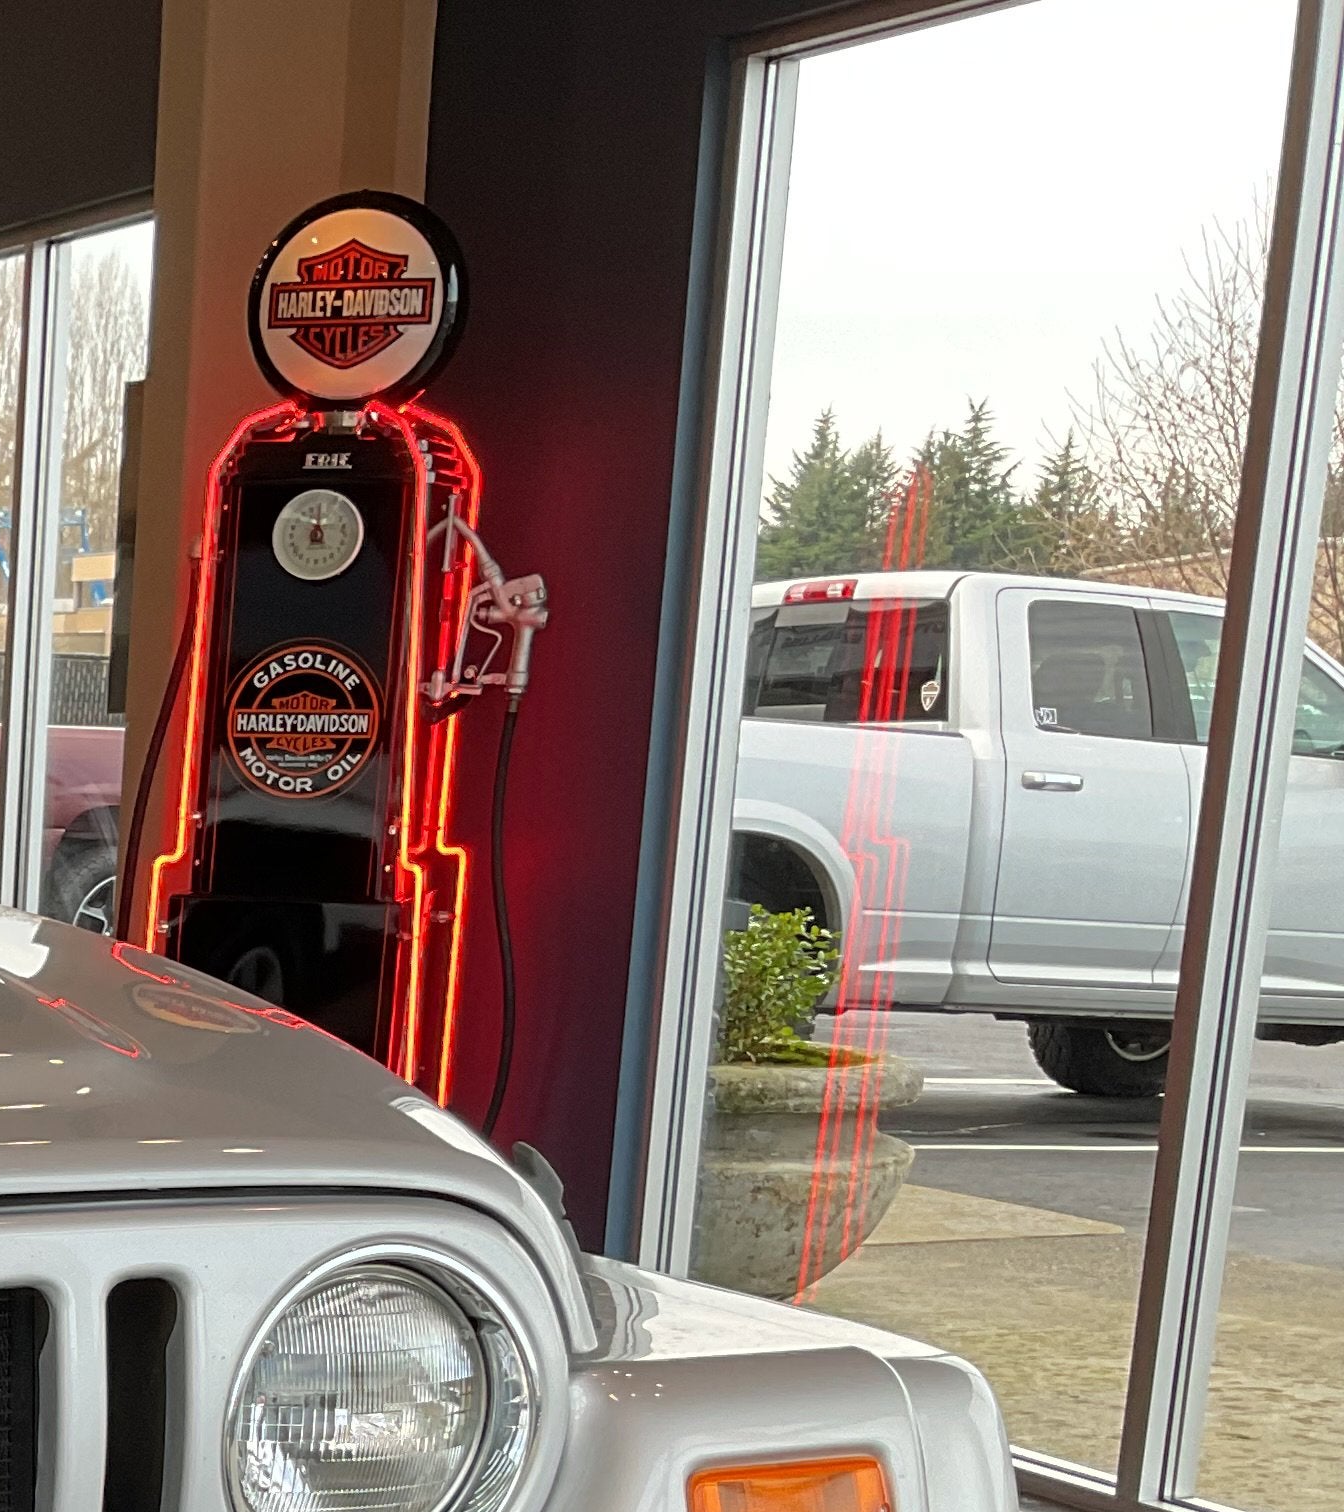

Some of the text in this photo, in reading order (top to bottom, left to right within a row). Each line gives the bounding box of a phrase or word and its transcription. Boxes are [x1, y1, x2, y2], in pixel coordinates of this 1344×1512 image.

[313, 252, 389, 280] MOTOR
[278, 288, 423, 318] HARLEY-DAVIDSON
[309, 327, 384, 358] CYCLES
[303, 453, 352, 468] ERIE
[252, 652, 360, 691] GASOLINE
[279, 694, 330, 711] MOTOR
[277, 737, 327, 752] CYCLES
[238, 747, 362, 792] MOTOR OIL
